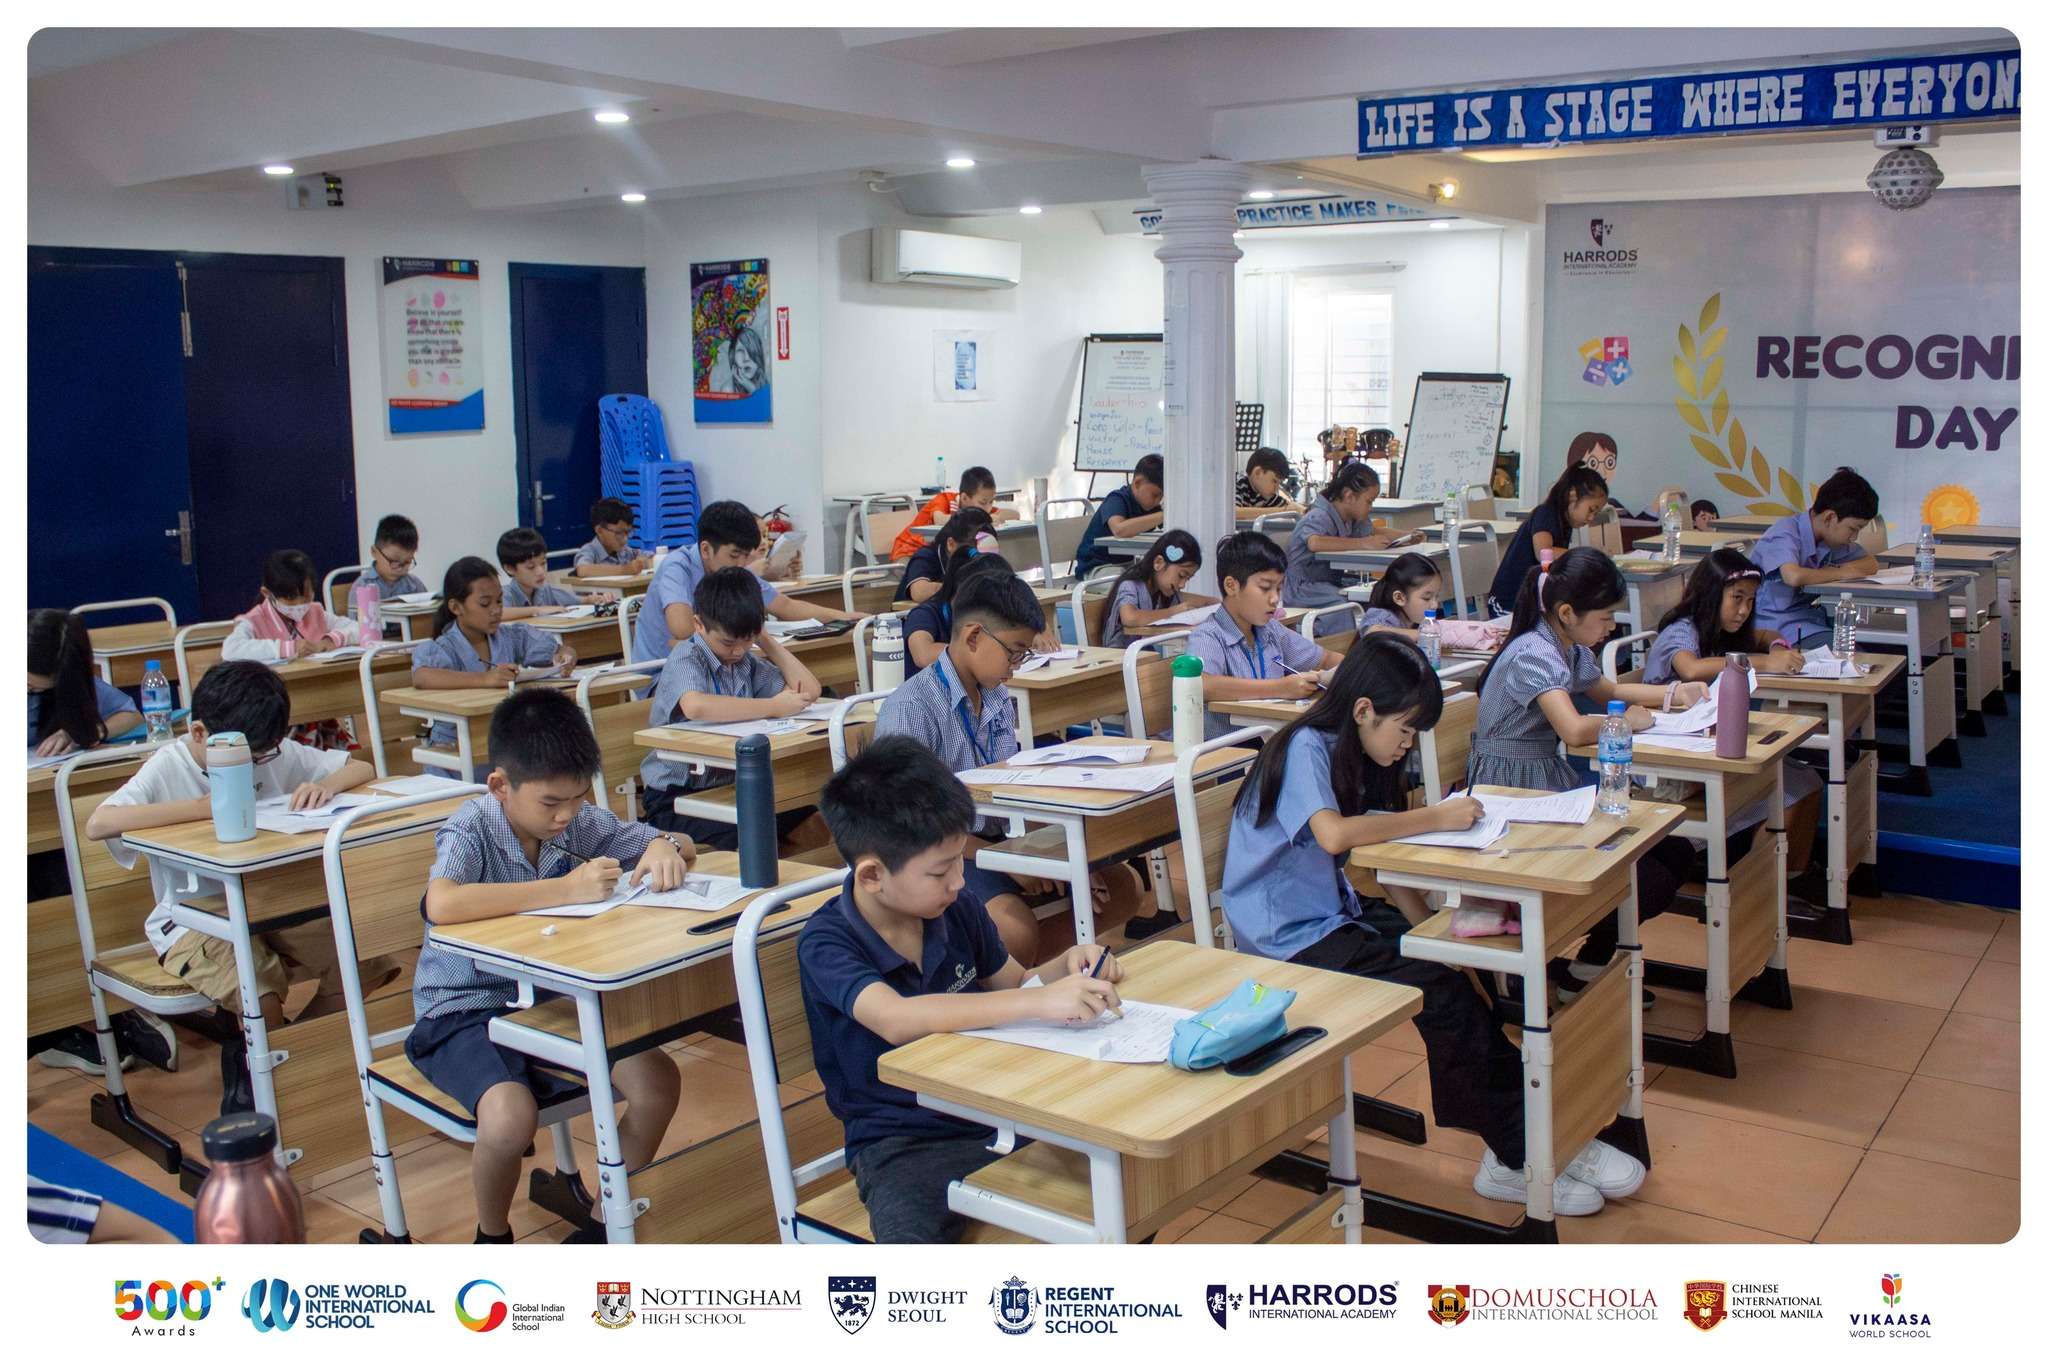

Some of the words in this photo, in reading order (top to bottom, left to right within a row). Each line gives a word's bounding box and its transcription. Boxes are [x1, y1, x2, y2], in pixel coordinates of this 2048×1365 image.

[1366, 102, 1434, 148] LIFE
[1454, 96, 1493, 142] IS
[1507, 95, 1526, 138] A
[1545, 86, 1653, 137] STAGE
[1681, 74, 1804, 128] WHERE
[1236, 204, 1314, 225] PRACTICE
[1319, 200, 1376, 219] MAKES
[1563, 249, 1639, 263] HARRODS
[1895, 405, 2018, 451] DAY
